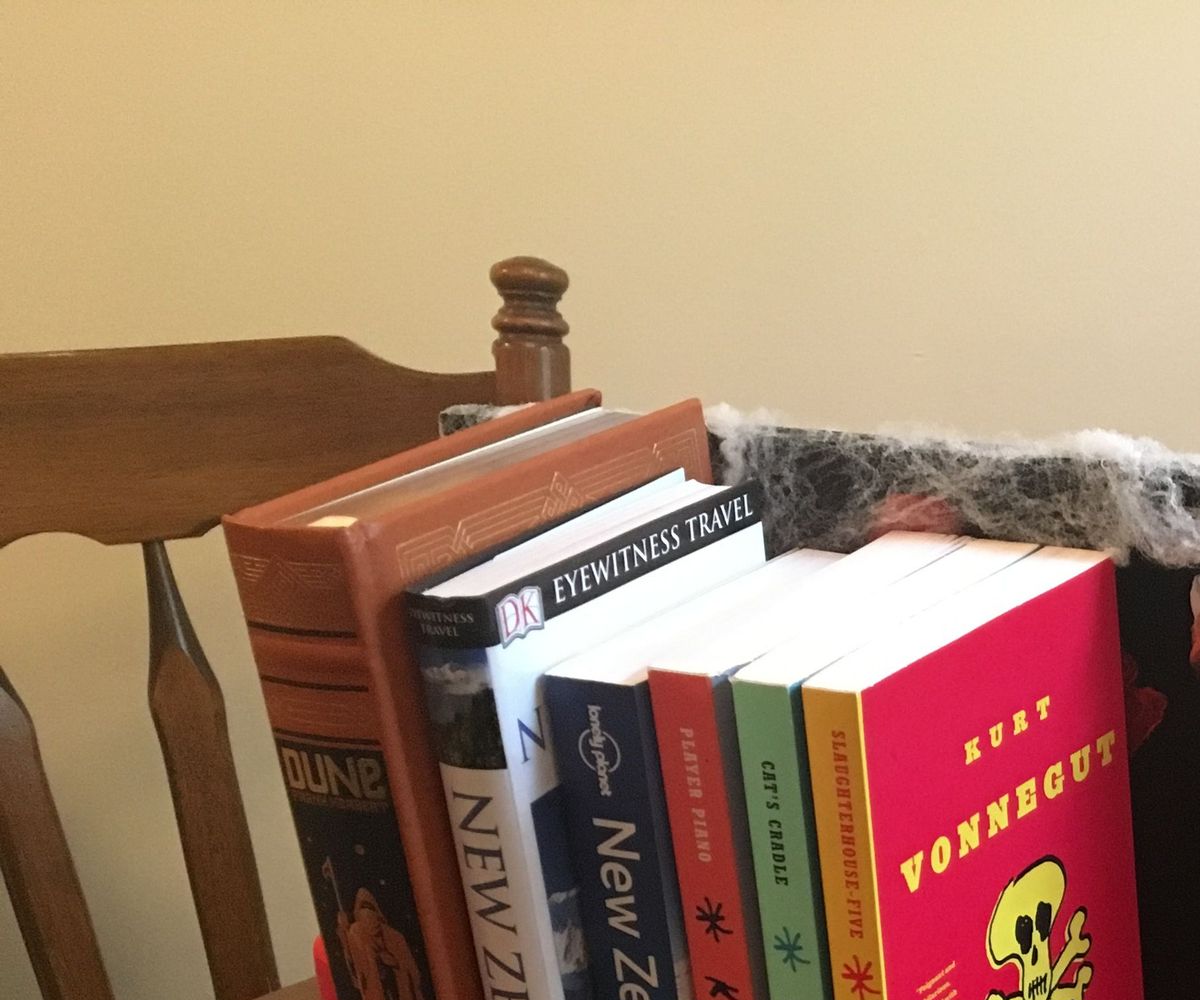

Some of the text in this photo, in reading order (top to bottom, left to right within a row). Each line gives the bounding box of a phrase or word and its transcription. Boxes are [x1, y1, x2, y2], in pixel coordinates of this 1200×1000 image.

[552, 494, 753, 603] EYEWITNESS TRAVEL
[501, 591, 539, 637] DK
[587, 704, 612, 796] lonely planet
[964, 695, 1050, 765] KURT
[680, 727, 712, 862] PLAYER PIANO
[761, 760, 788, 886] CAT'S CRADLE
[831, 730, 864, 939] SLAUGHTERHOUSE-FIVE
[900, 730, 1116, 893] VONNEGUT
[452, 791, 518, 936] NEW
[592, 817, 641, 939] New
